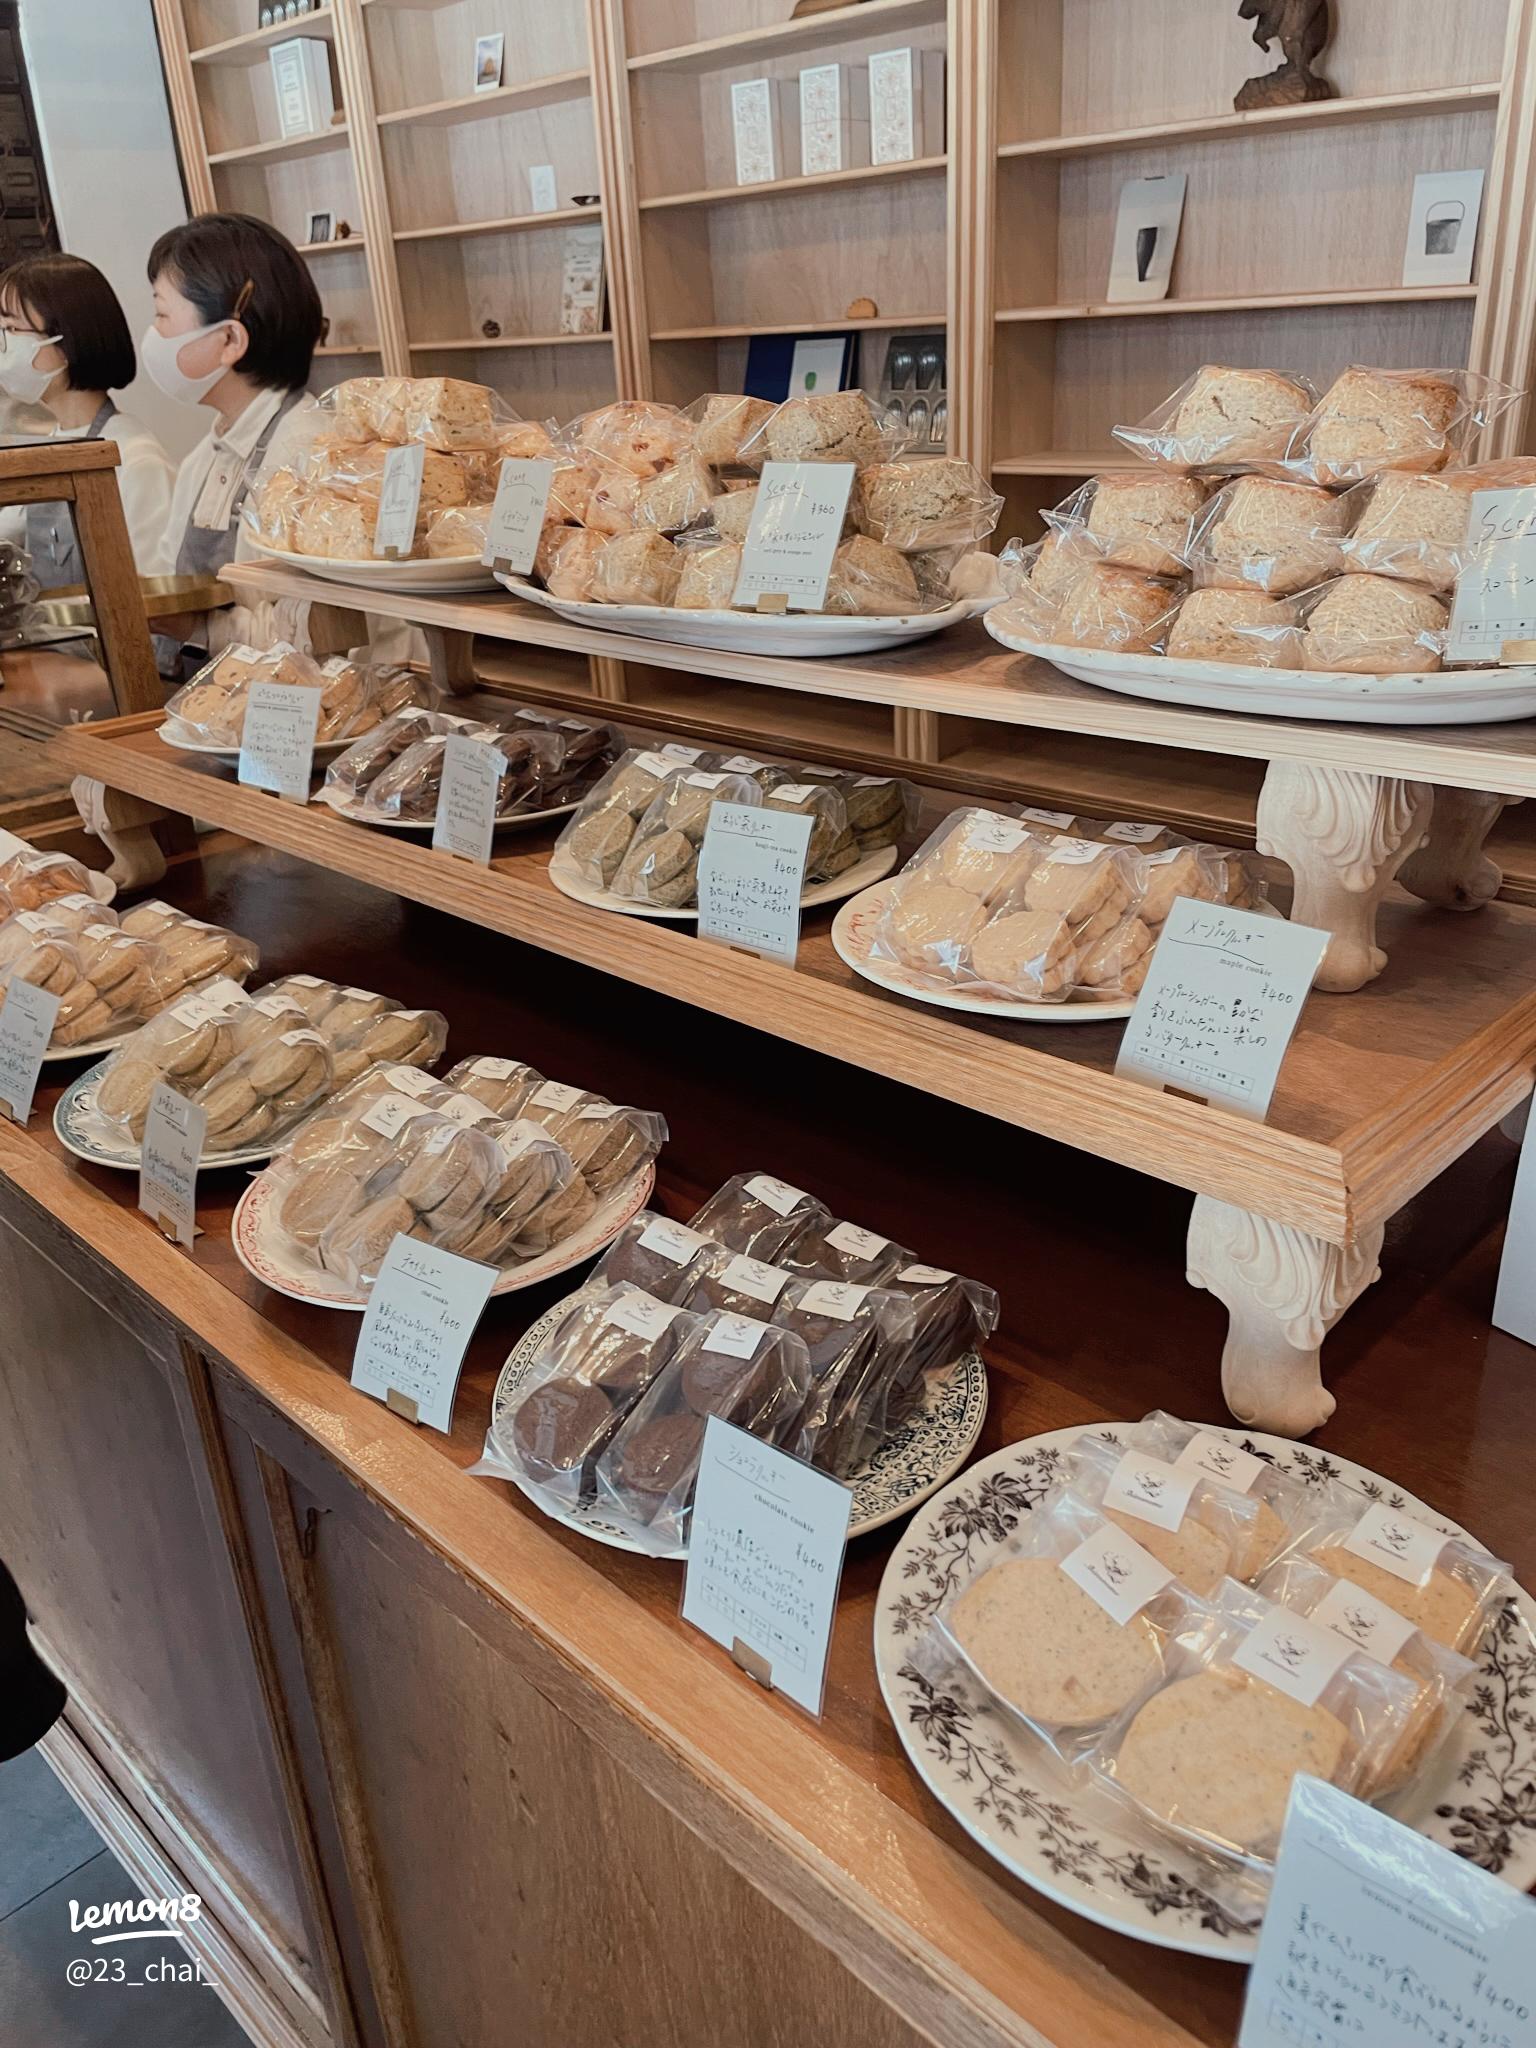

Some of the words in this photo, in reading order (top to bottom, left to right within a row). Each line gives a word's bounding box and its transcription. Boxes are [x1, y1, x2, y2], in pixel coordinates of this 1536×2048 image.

[1219, 957, 1244, 972] maple
[1246, 961, 1273, 977] cookie
[1260, 982, 1294, 1004] ¥400
[753, 1492, 789, 1522] chocolate
[789, 1513, 815, 1535] cookie
[795, 1542, 825, 1574] ¥400
[1471, 1970, 1530, 2021] ¥400
